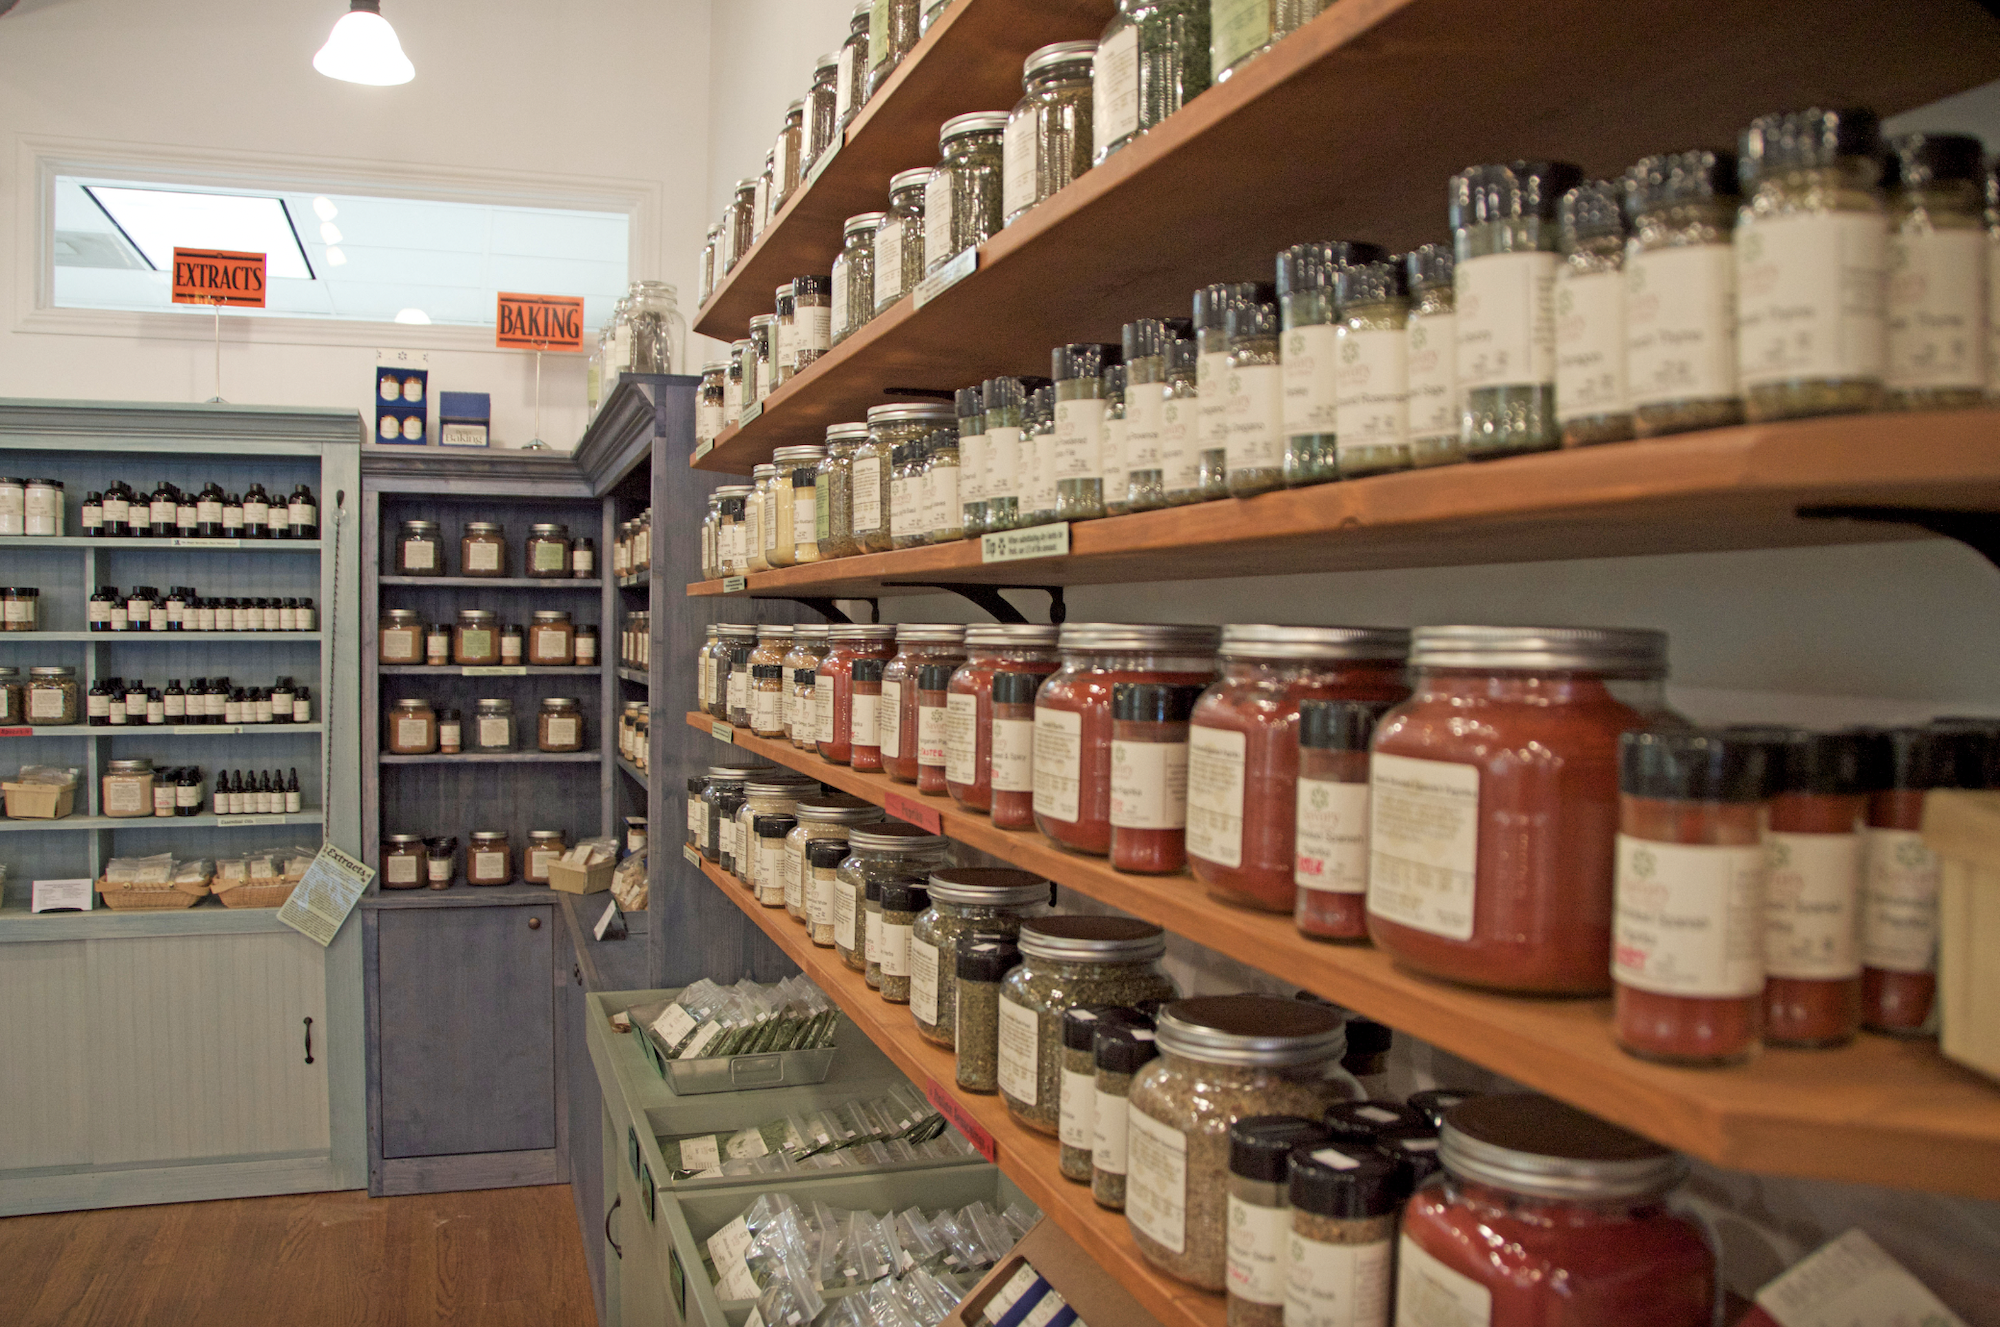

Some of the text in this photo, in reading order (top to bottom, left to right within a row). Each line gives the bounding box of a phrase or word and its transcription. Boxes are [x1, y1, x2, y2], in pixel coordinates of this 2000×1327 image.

[175, 262, 263, 291] EXTRACTS
[499, 304, 580, 339] BAKING
[445, 433, 483, 444] Baking
[985, 538, 996, 557] Tip
[326, 847, 367, 877] Extracts
